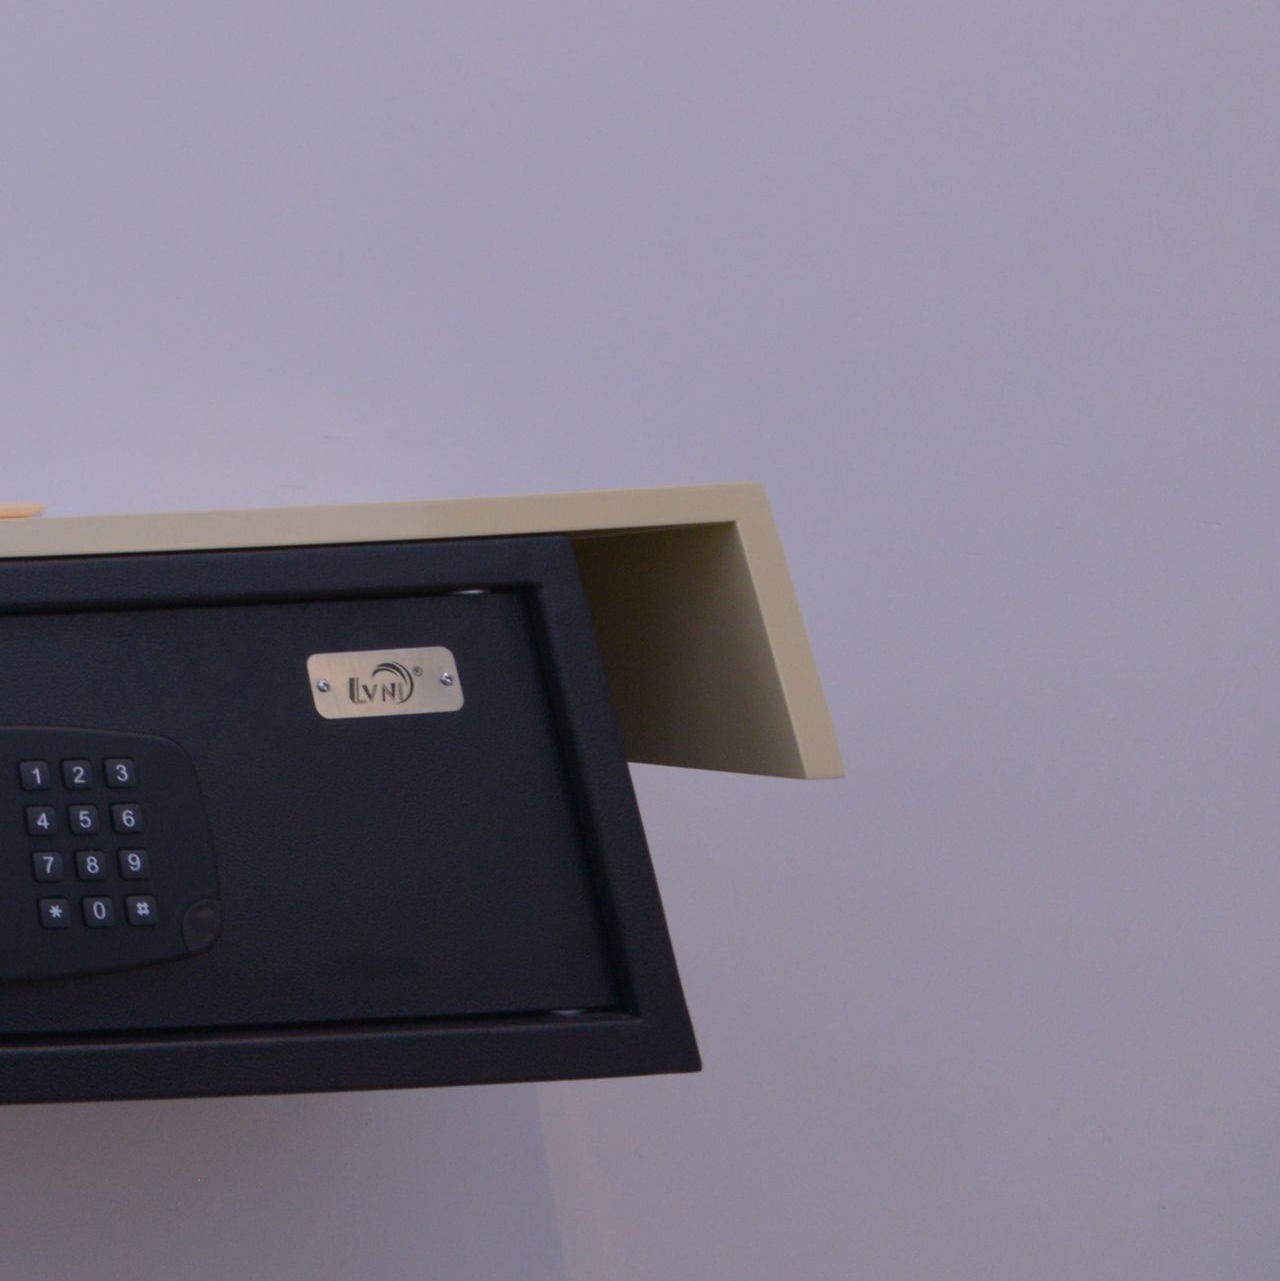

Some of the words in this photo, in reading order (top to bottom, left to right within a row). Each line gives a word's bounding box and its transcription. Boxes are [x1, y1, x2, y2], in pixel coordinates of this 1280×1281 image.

[32, 768, 41, 784] 1
[72, 766, 86, 784] 2
[115, 764, 129, 782] 3
[36, 812, 50, 829] 4
[78, 810, 92, 828] 5
[121, 809, 135, 827] 6
[43, 856, 54, 873] 7
[86, 856, 99, 873] 8
[127, 853, 141, 871] 9
[93, 901, 106, 919] 0
